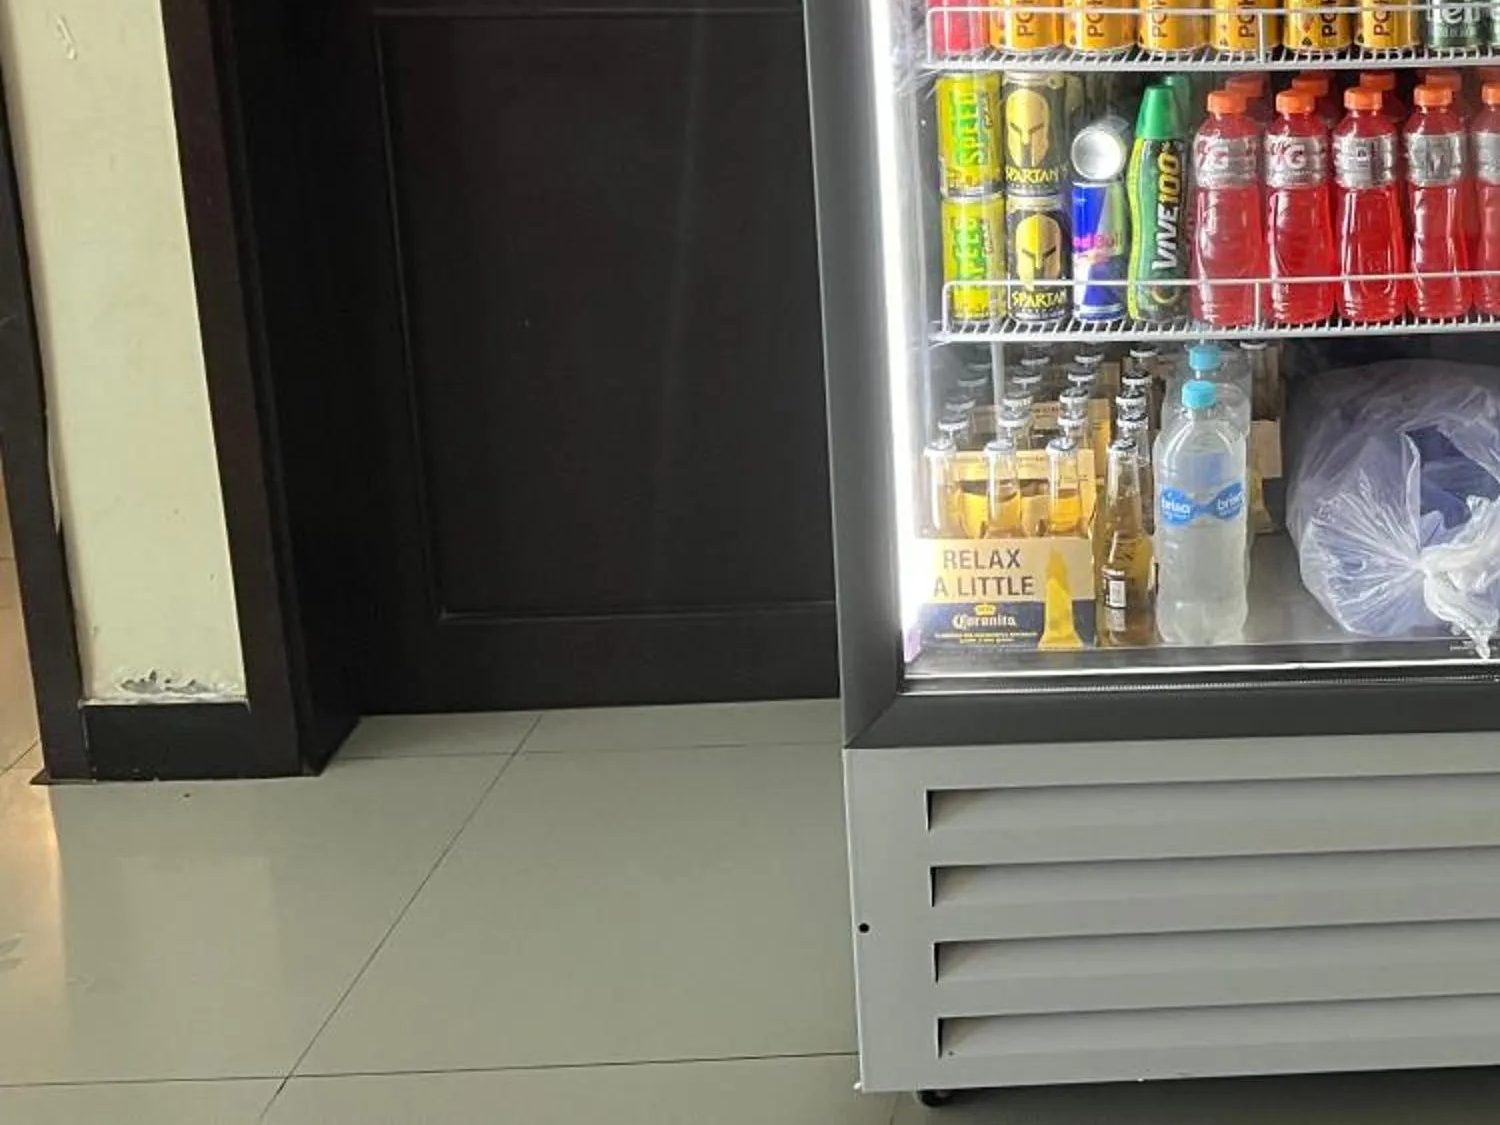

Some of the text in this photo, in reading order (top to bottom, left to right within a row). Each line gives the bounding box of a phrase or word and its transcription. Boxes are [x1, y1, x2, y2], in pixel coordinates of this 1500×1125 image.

[943, 548, 1021, 570] RELAX
[933, 576, 1035, 597] A LITTLE
[952, 612, 1017, 630] Coronita
